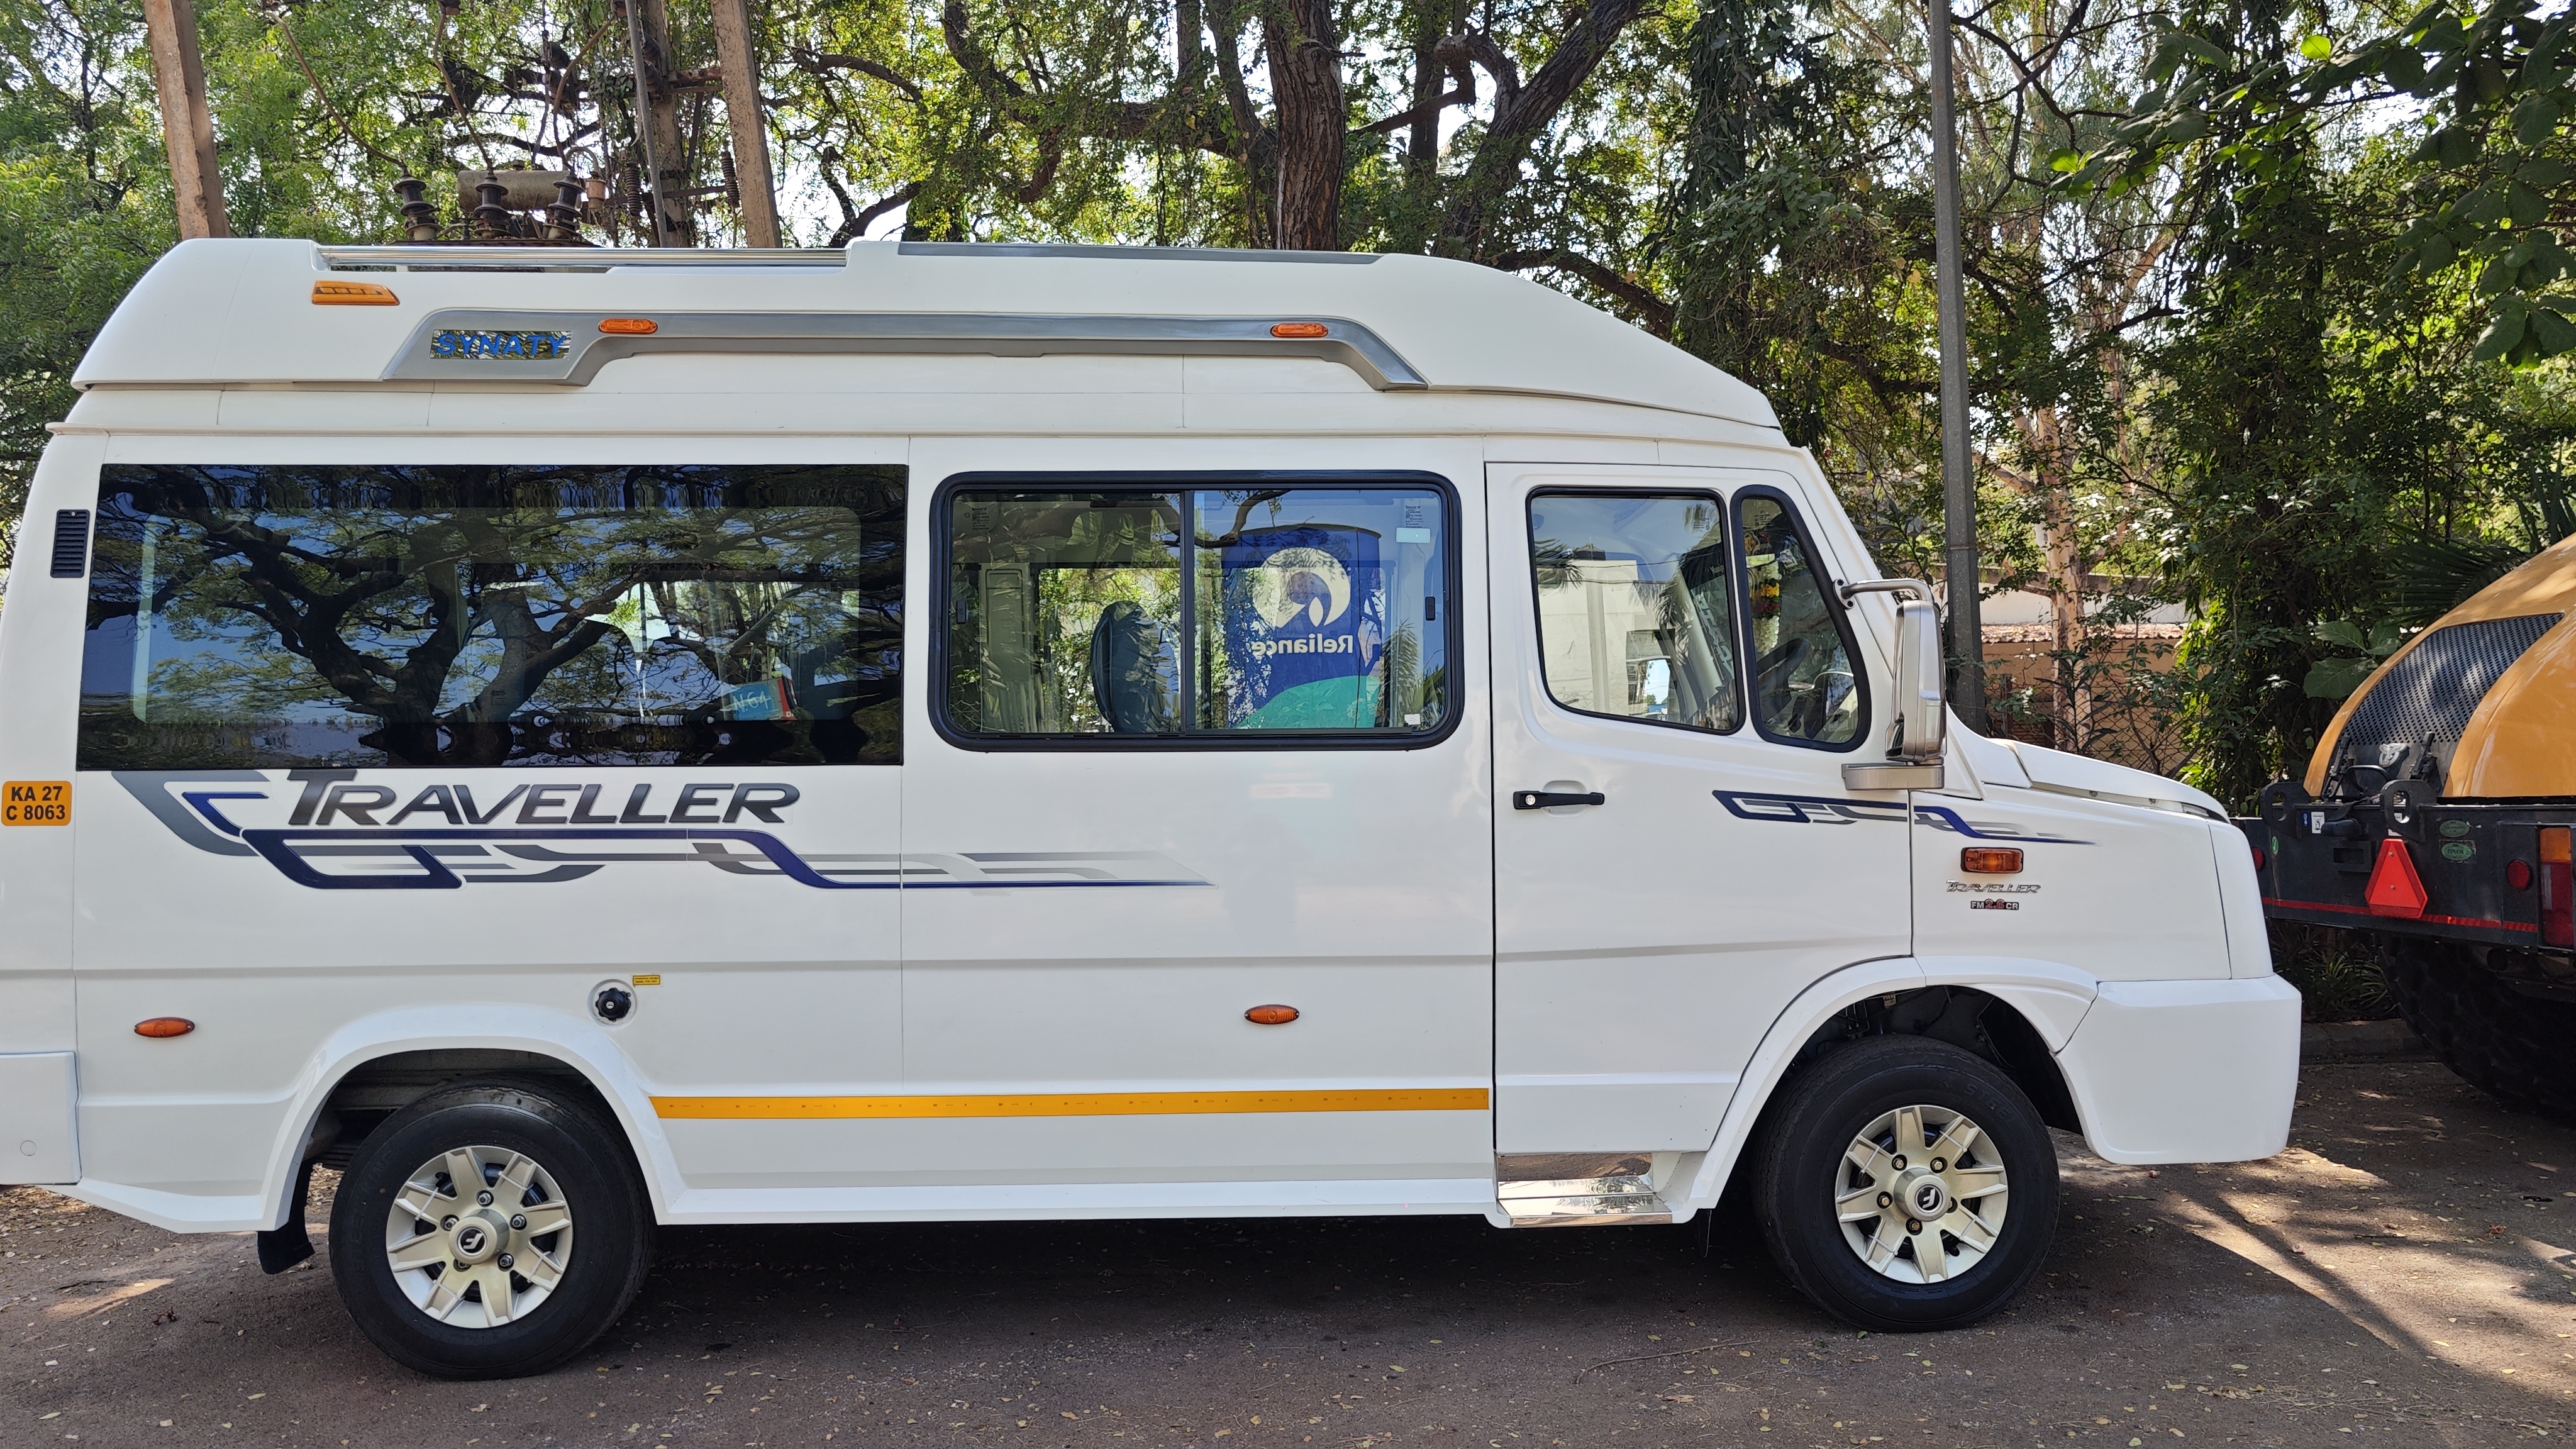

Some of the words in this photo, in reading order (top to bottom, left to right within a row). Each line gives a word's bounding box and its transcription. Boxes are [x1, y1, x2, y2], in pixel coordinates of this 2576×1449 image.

[436, 333, 566, 356] SYNATY
[11, 786, 36, 801] KA
[42, 786, 62, 801] 27
[6, 805, 18, 820] C
[24, 804, 65, 820] 8063
